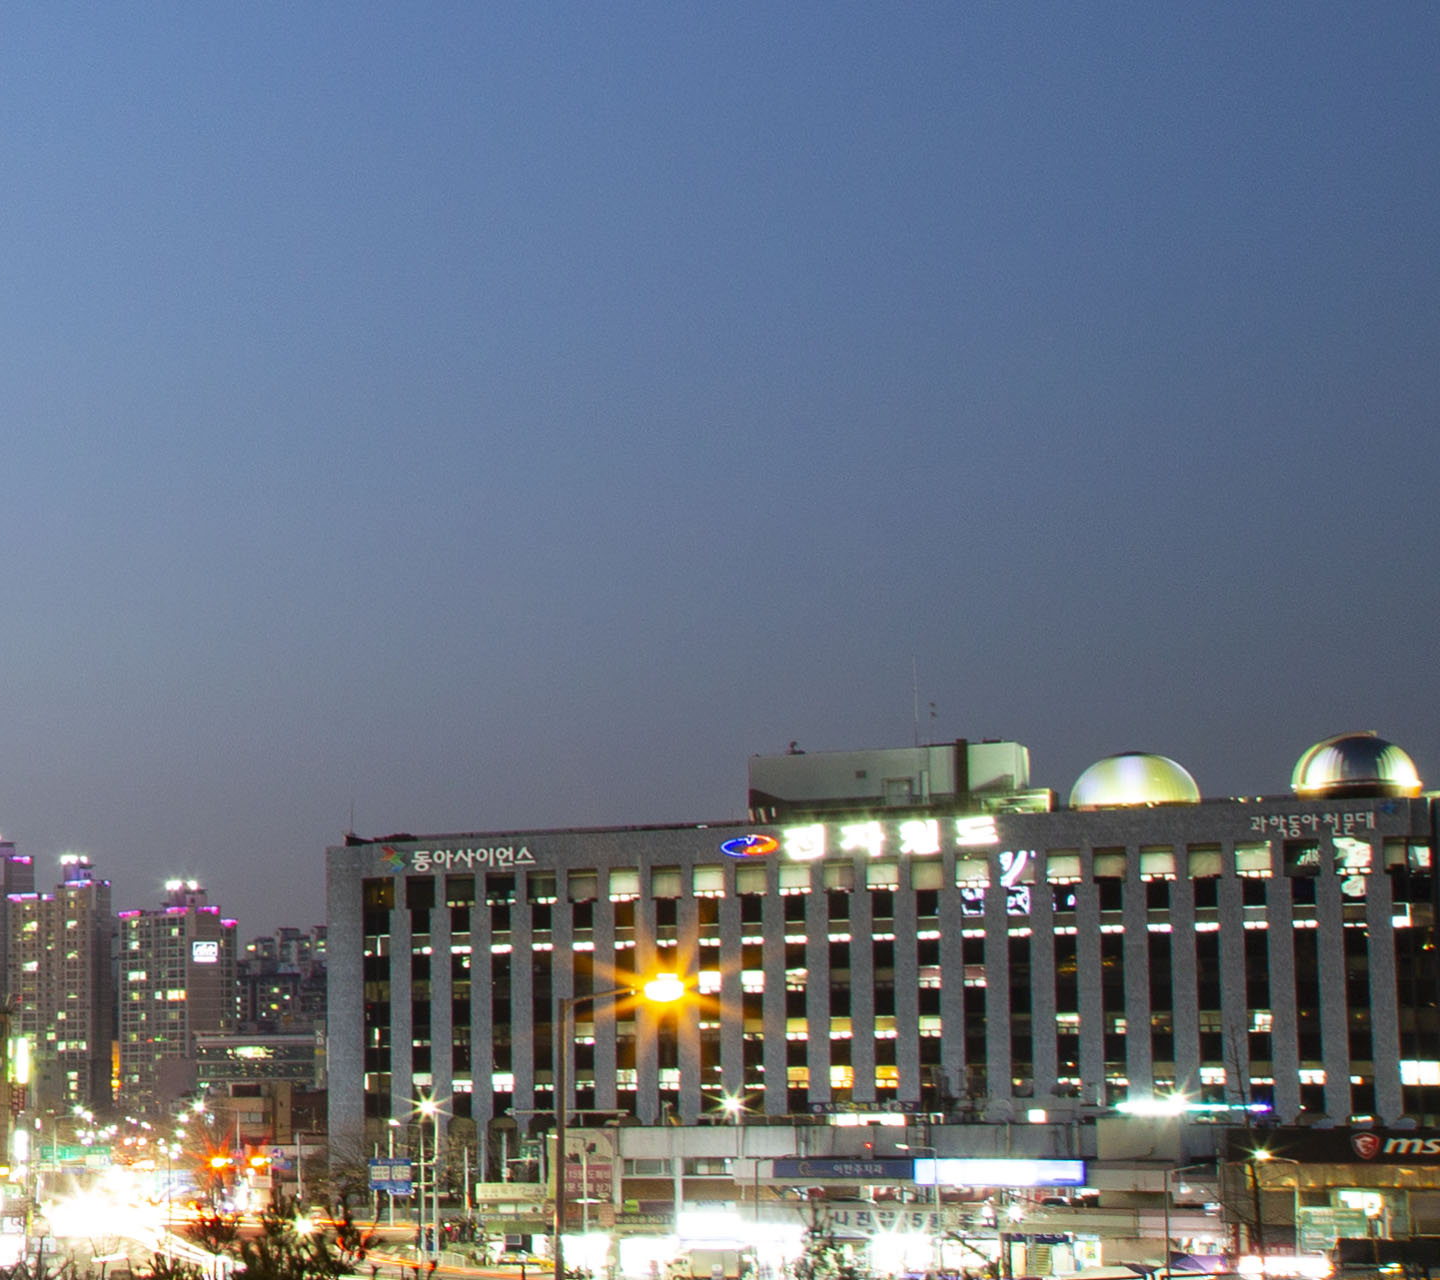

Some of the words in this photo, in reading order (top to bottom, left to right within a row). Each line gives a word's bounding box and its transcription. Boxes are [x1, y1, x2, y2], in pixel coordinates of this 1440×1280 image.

[1250, 813, 1319, 837] 과학동아
[1322, 811, 1376, 836] 천문대
[411, 846, 536, 872] 동아사이언스
